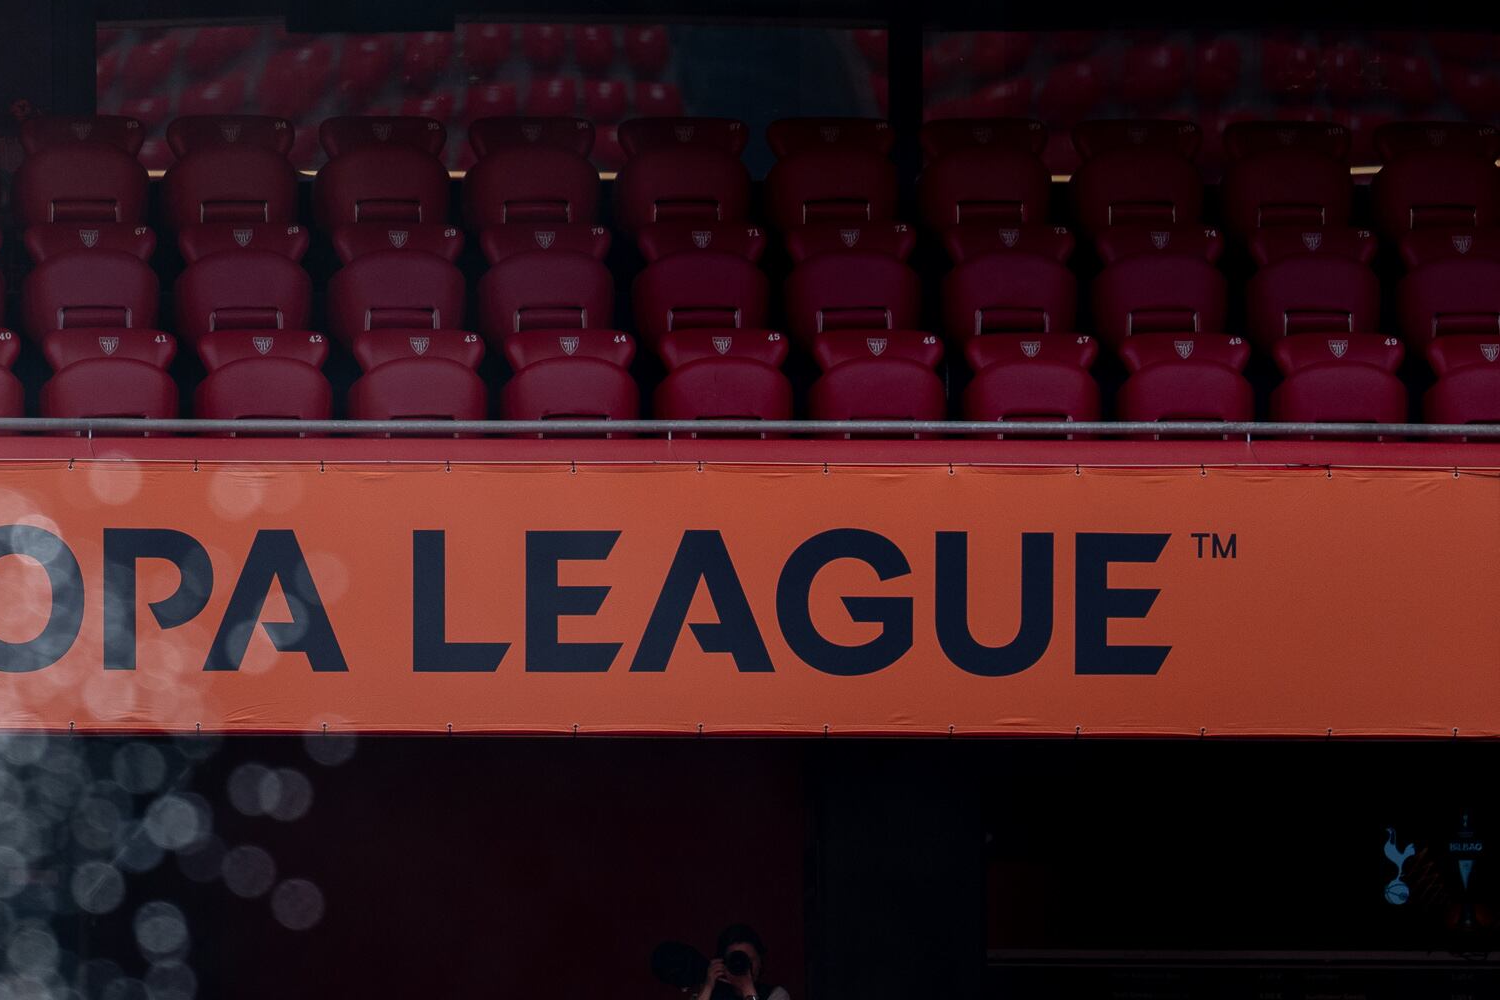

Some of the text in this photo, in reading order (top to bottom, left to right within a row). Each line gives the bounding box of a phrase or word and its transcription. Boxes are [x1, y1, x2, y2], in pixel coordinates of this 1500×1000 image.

[126, 120, 139, 129] 93
[275, 120, 287, 130] 94
[427, 122, 440, 130] 95
[576, 121, 589, 130] 96
[134, 226, 147, 236] 67
[287, 225, 300, 235] 68
[444, 228, 457, 238] 69
[591, 227, 604, 236] 70
[747, 228, 760, 237] 71
[894, 224, 908, 233] 72
[1054, 226, 1068, 235] 73
[1204, 229, 1217, 238] 74
[1357, 230, 1370, 239] 75
[154, 334, 167, 344] 41
[308, 334, 323, 343] 42
[464, 334, 477, 343] 43
[613, 334, 627, 344] 44
[767, 333, 781, 342] 45
[923, 336, 936, 345] 46
[1076, 335, 1090, 345] 47
[1228, 337, 1242, 346] 48
[1384, 337, 1398, 346] 49
[412, 527, 1174, 677] LEAGUE
